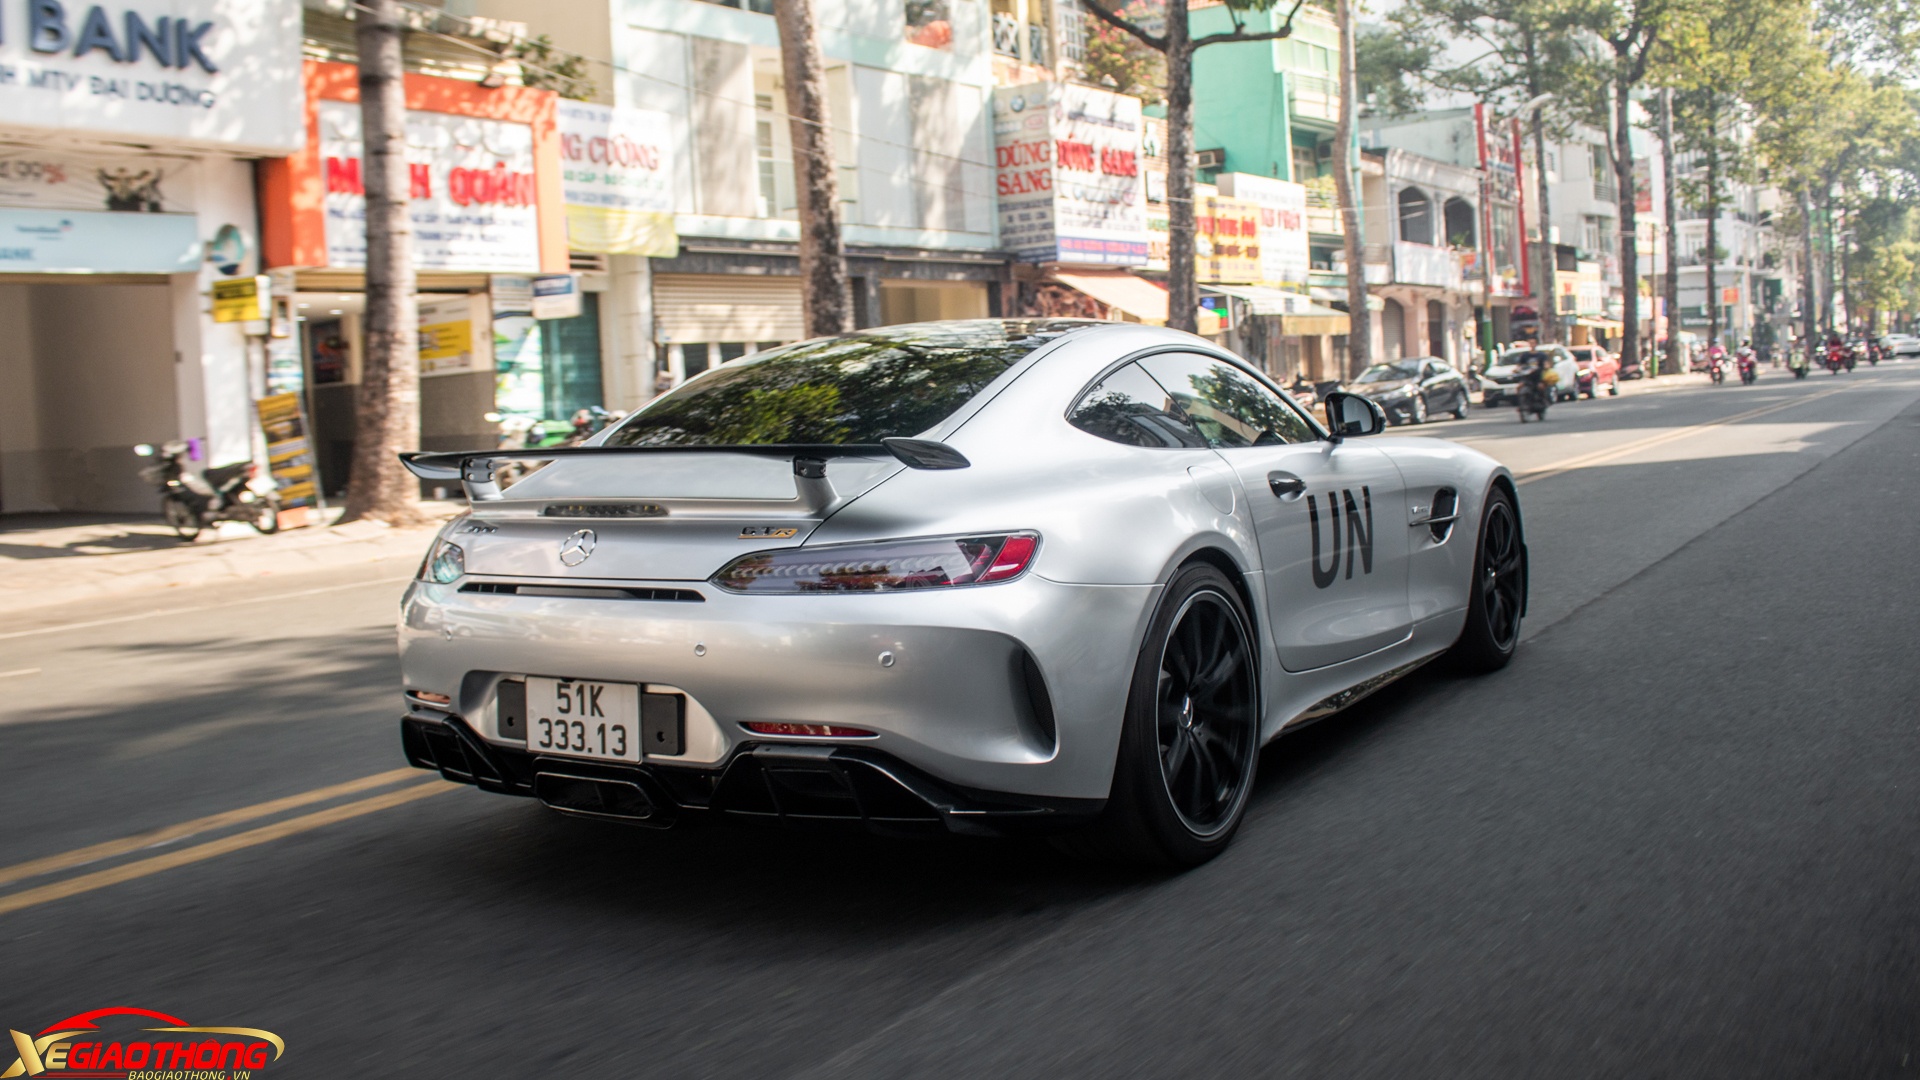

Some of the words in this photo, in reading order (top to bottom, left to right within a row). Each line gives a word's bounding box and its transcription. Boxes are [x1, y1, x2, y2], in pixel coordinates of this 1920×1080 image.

[29, 0, 219, 74] BANK
[996, 140, 1050, 168] DŨNG
[996, 167, 1053, 196] SANG
[1307, 485, 1374, 589] UN
[557, 682, 605, 718] 51K
[538, 717, 627, 757] 333.13
